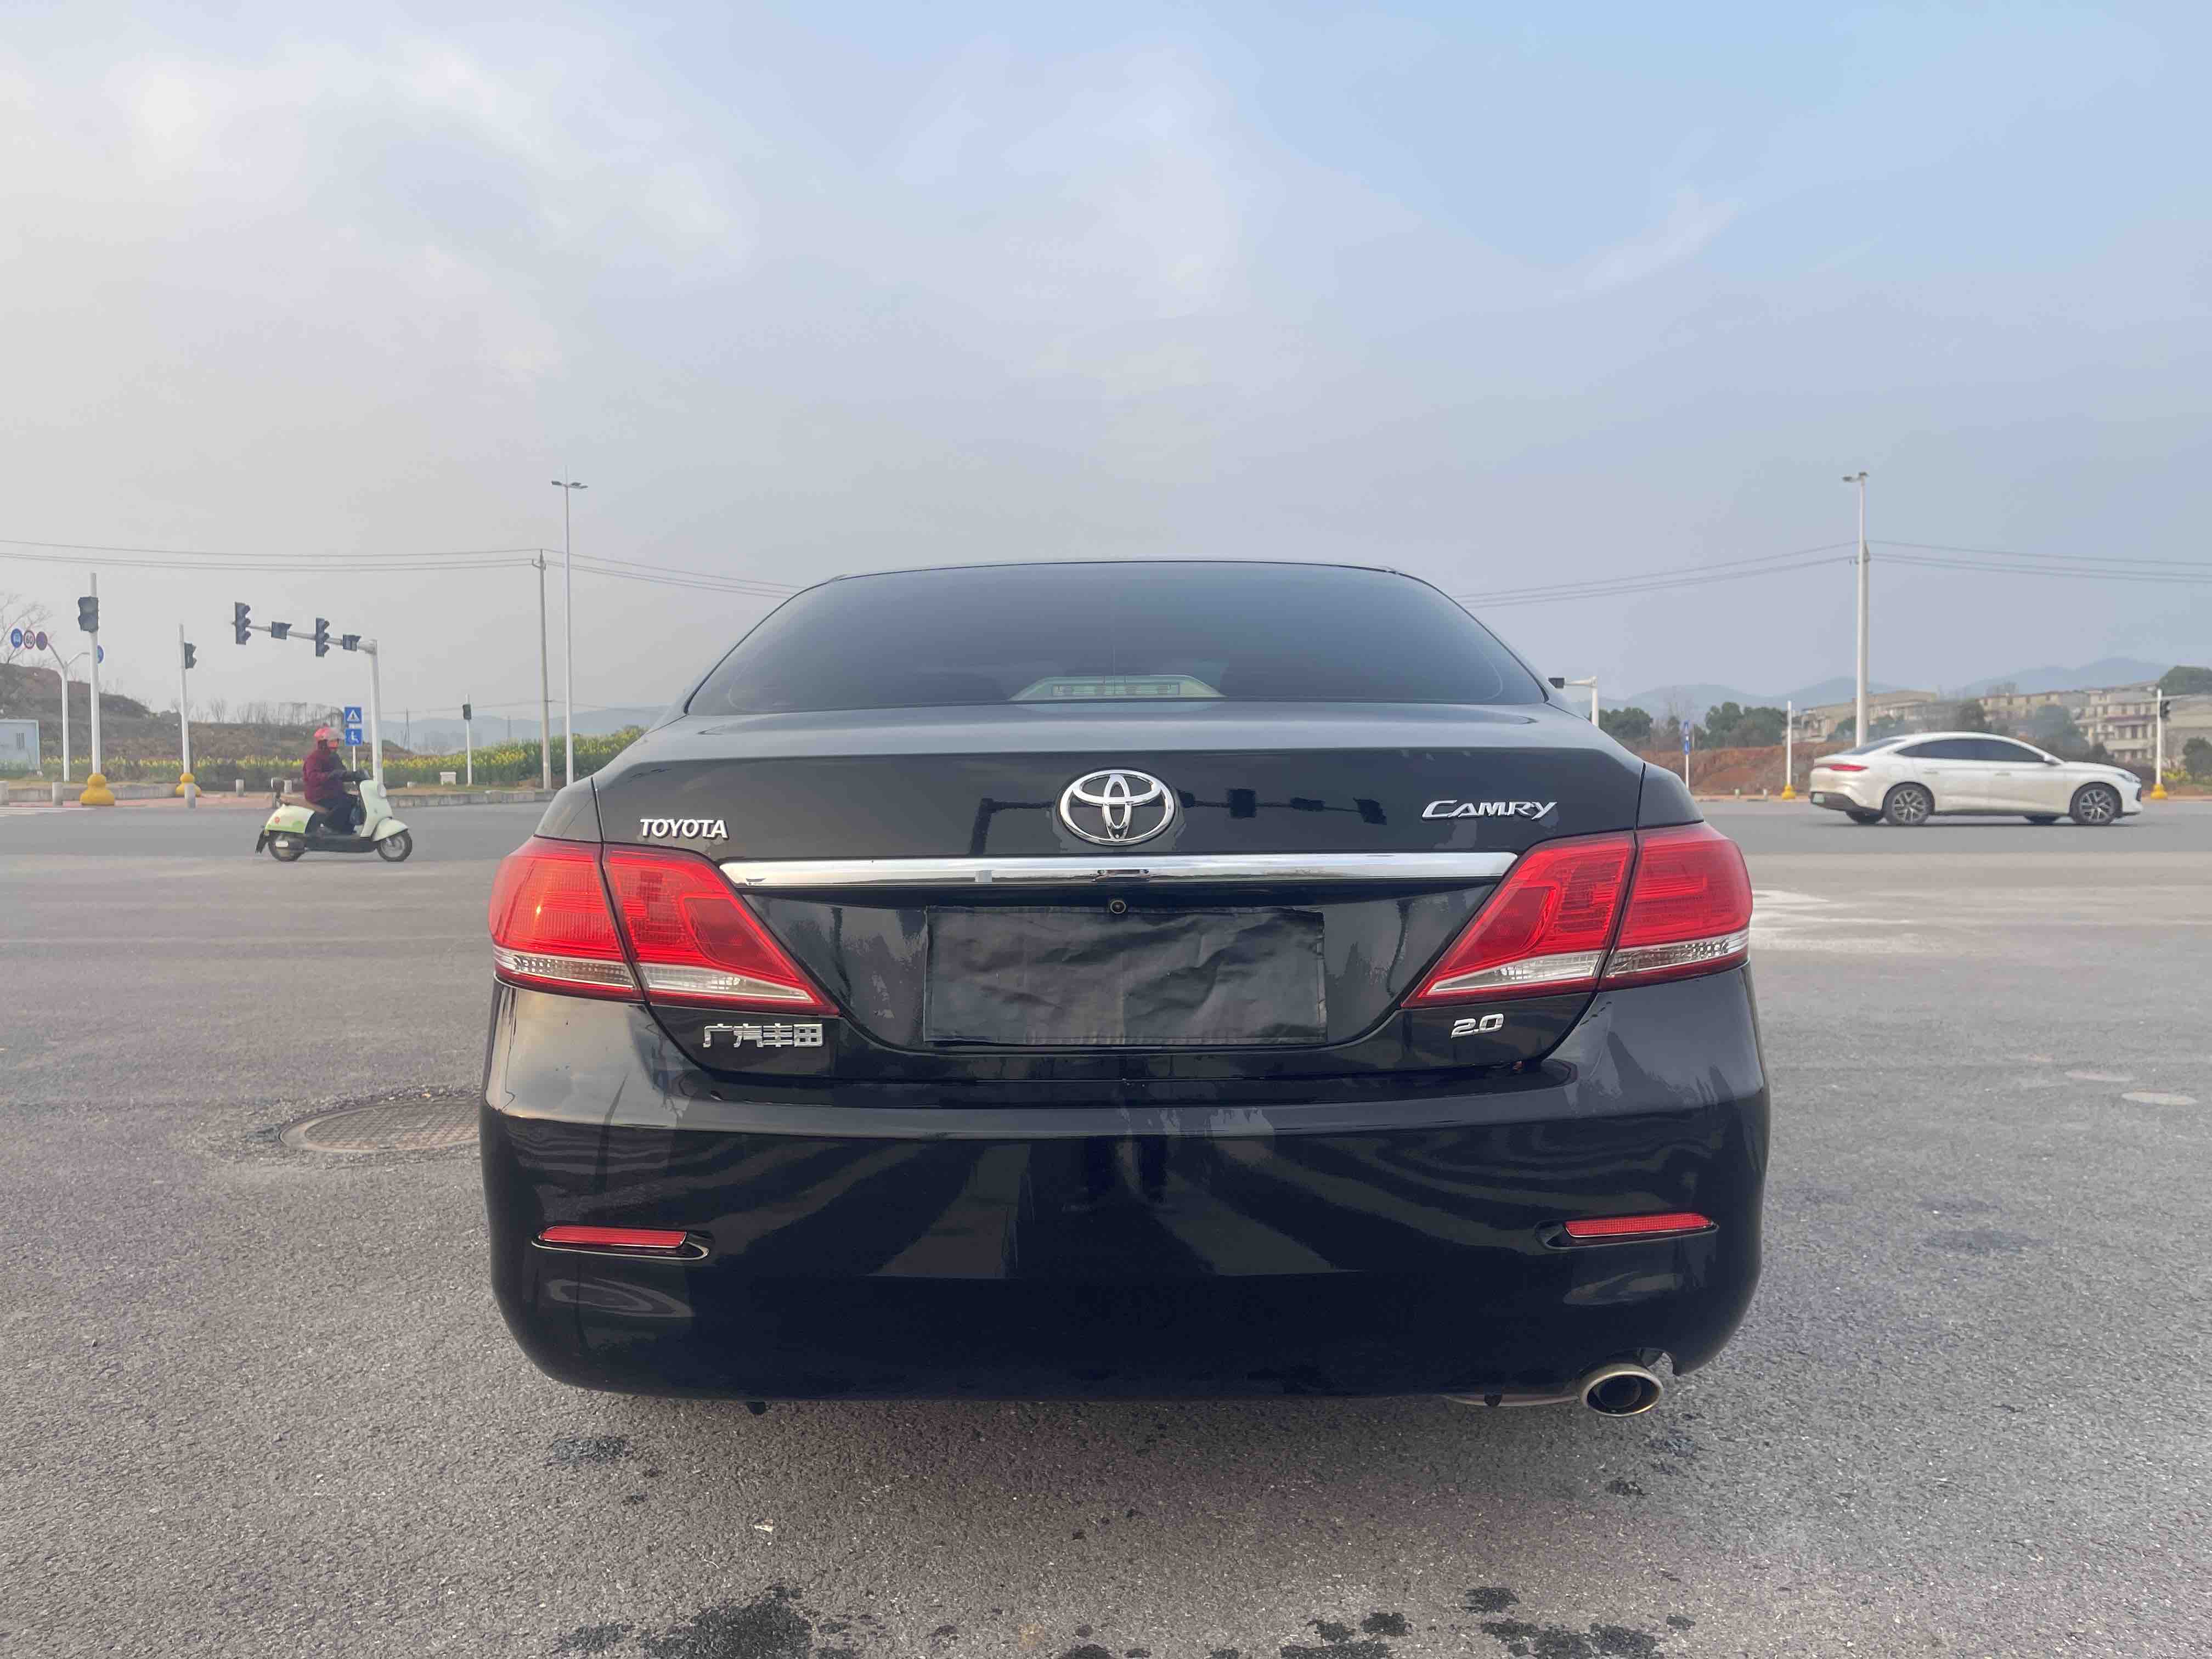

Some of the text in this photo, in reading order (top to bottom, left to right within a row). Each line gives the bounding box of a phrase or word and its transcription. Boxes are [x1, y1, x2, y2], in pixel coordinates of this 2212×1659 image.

[26, 635, 33, 645] 60
[1421, 799, 1558, 821] CAMRY
[640, 818, 729, 840] TOYOTA
[703, 1023, 823, 1048] 广汽丰田
[1451, 1013, 1504, 1039] 2.0
